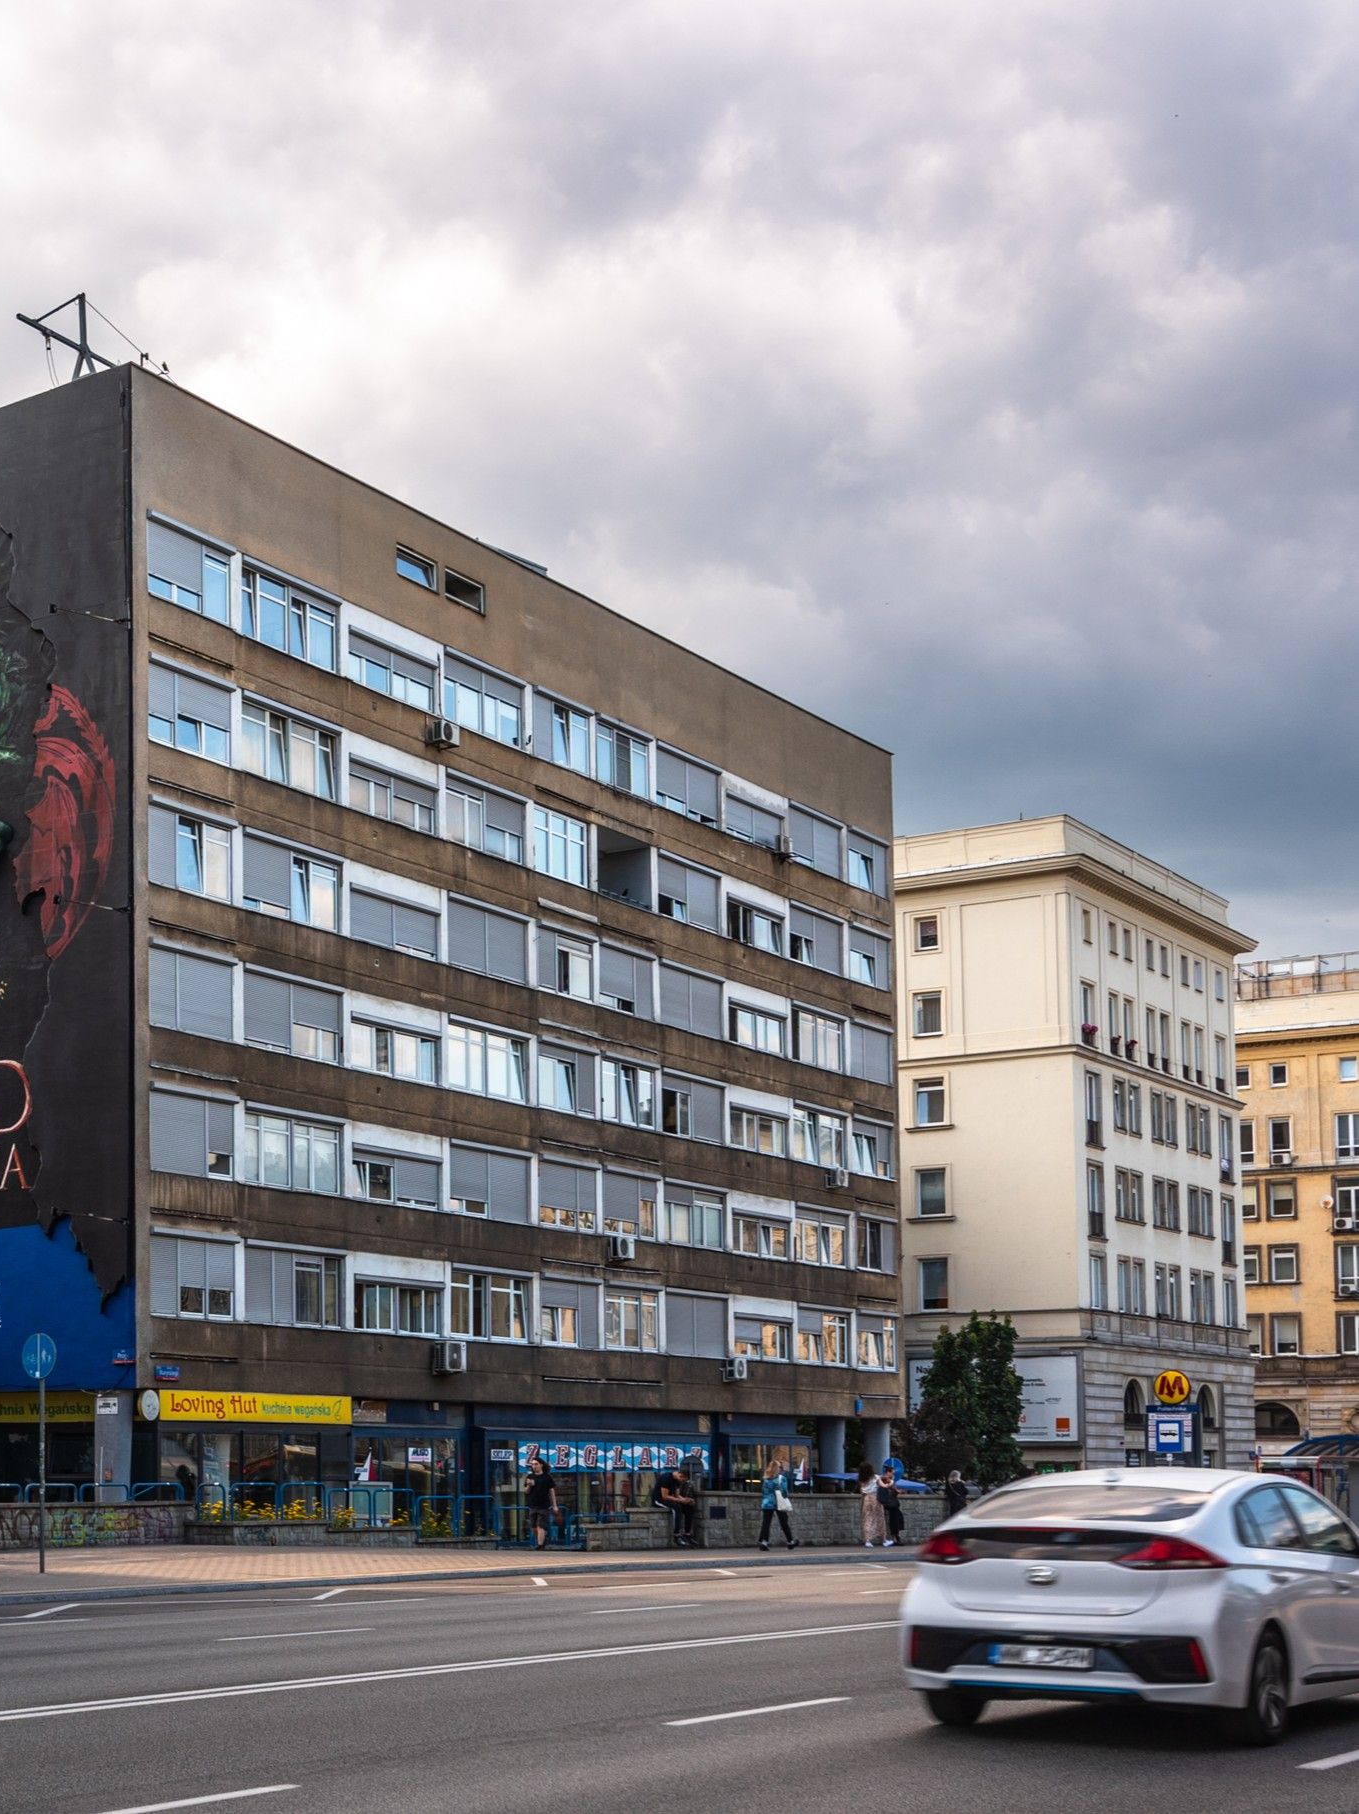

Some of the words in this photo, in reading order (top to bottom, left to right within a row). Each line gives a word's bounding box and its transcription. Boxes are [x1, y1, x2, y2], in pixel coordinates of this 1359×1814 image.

[28, 1402, 90, 1418] Wgańska
[170, 1393, 226, 1419] Loving
[230, 1395, 257, 1414] Hut
